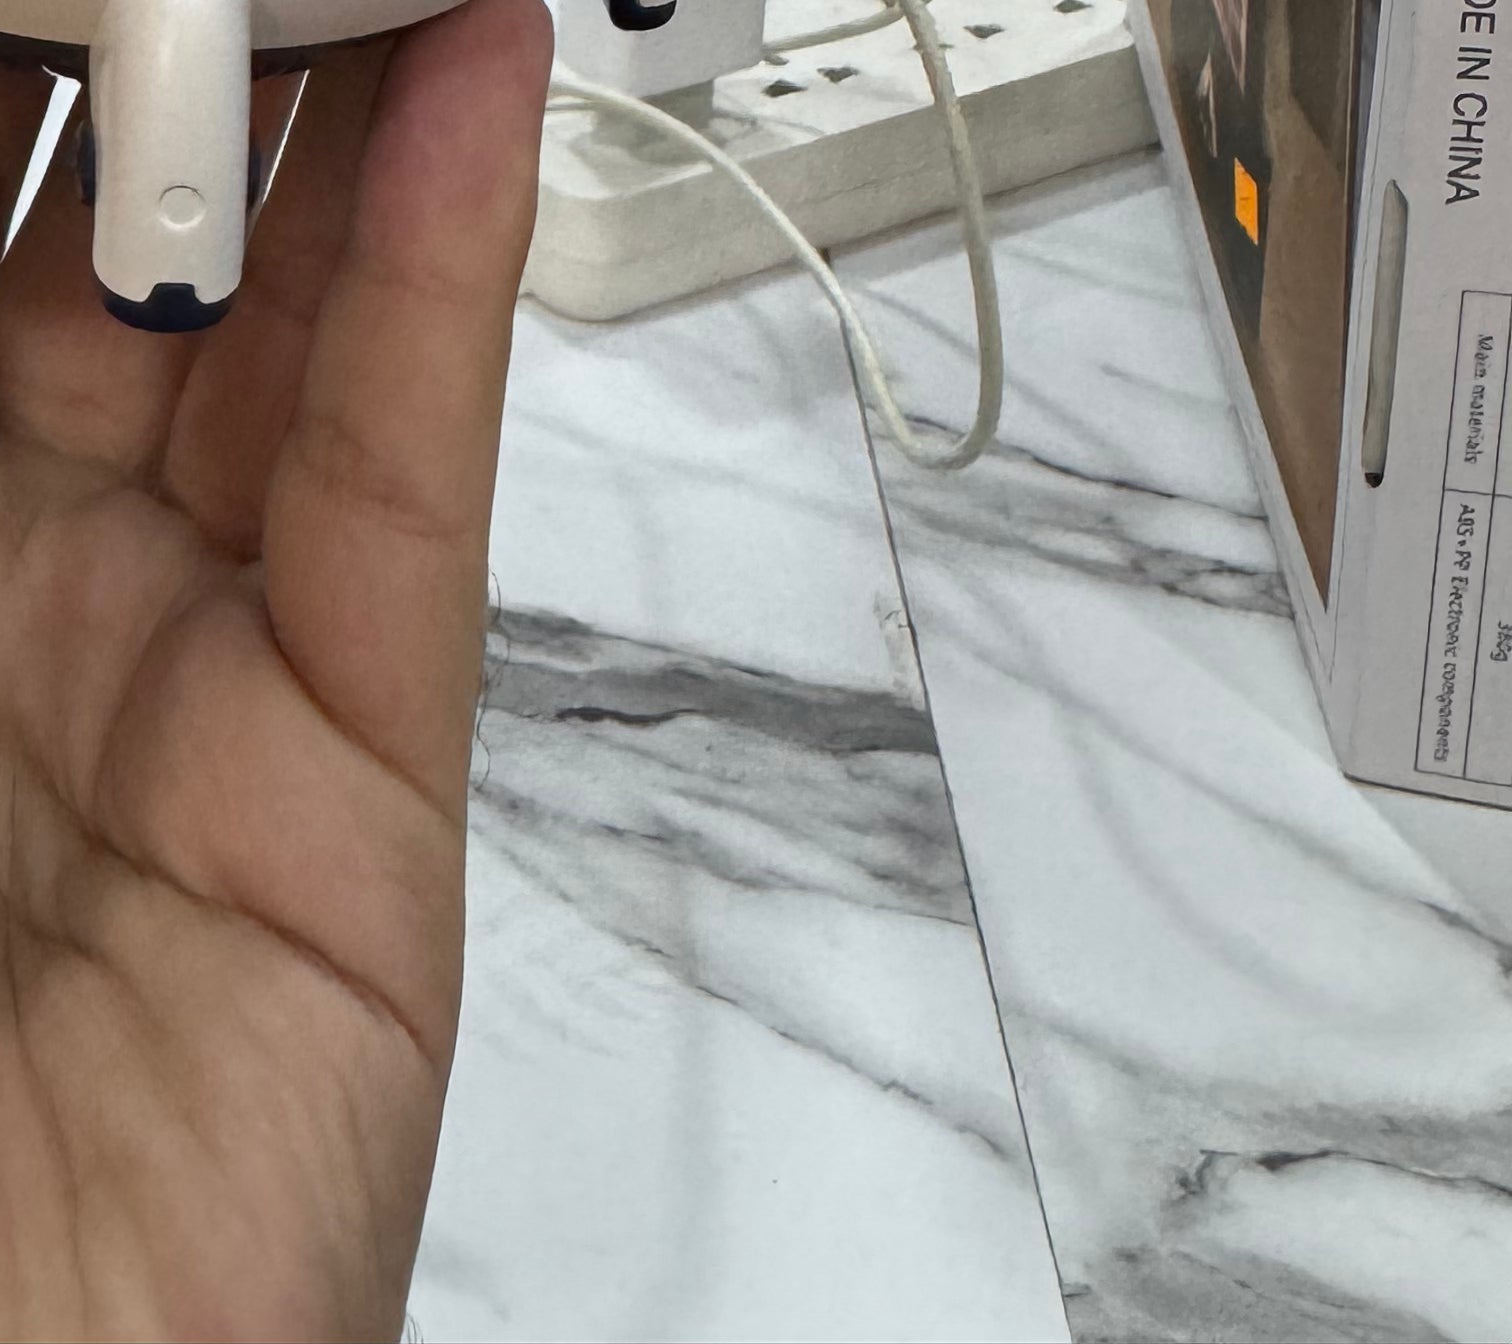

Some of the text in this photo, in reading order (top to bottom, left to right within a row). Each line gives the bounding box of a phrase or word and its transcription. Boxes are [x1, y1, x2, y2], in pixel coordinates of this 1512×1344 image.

[1456, 47, 1492, 81] IN
[1445, 92, 1489, 205] CHINA
[1464, 384, 1486, 465] materials
